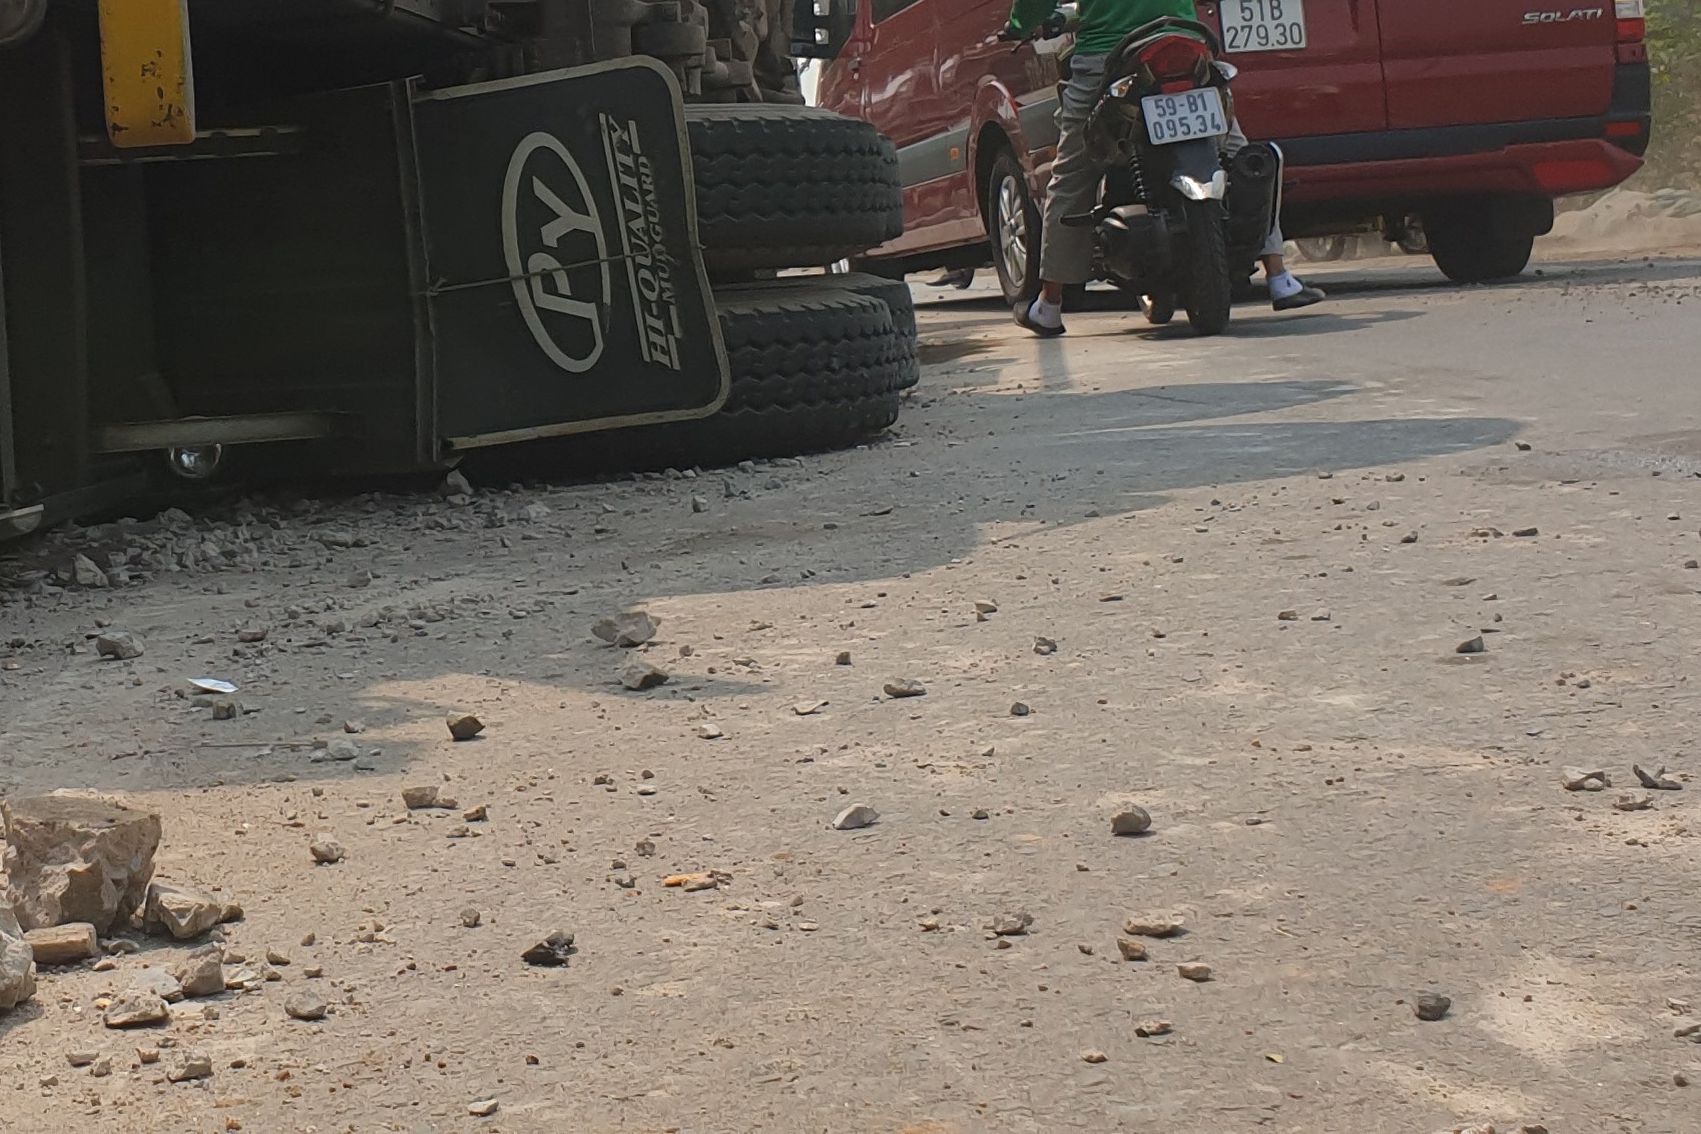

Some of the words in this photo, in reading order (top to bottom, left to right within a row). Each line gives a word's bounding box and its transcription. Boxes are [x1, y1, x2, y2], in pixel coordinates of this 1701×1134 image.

[1521, 8, 1603, 25] SOLATI
[1225, 22, 1303, 50] 279.30
[1153, 93, 1209, 118] 59-B1
[1152, 113, 1222, 141] 095.34
[527, 175, 600, 320] PY
[608, 115, 672, 369] HI-QUALITY
